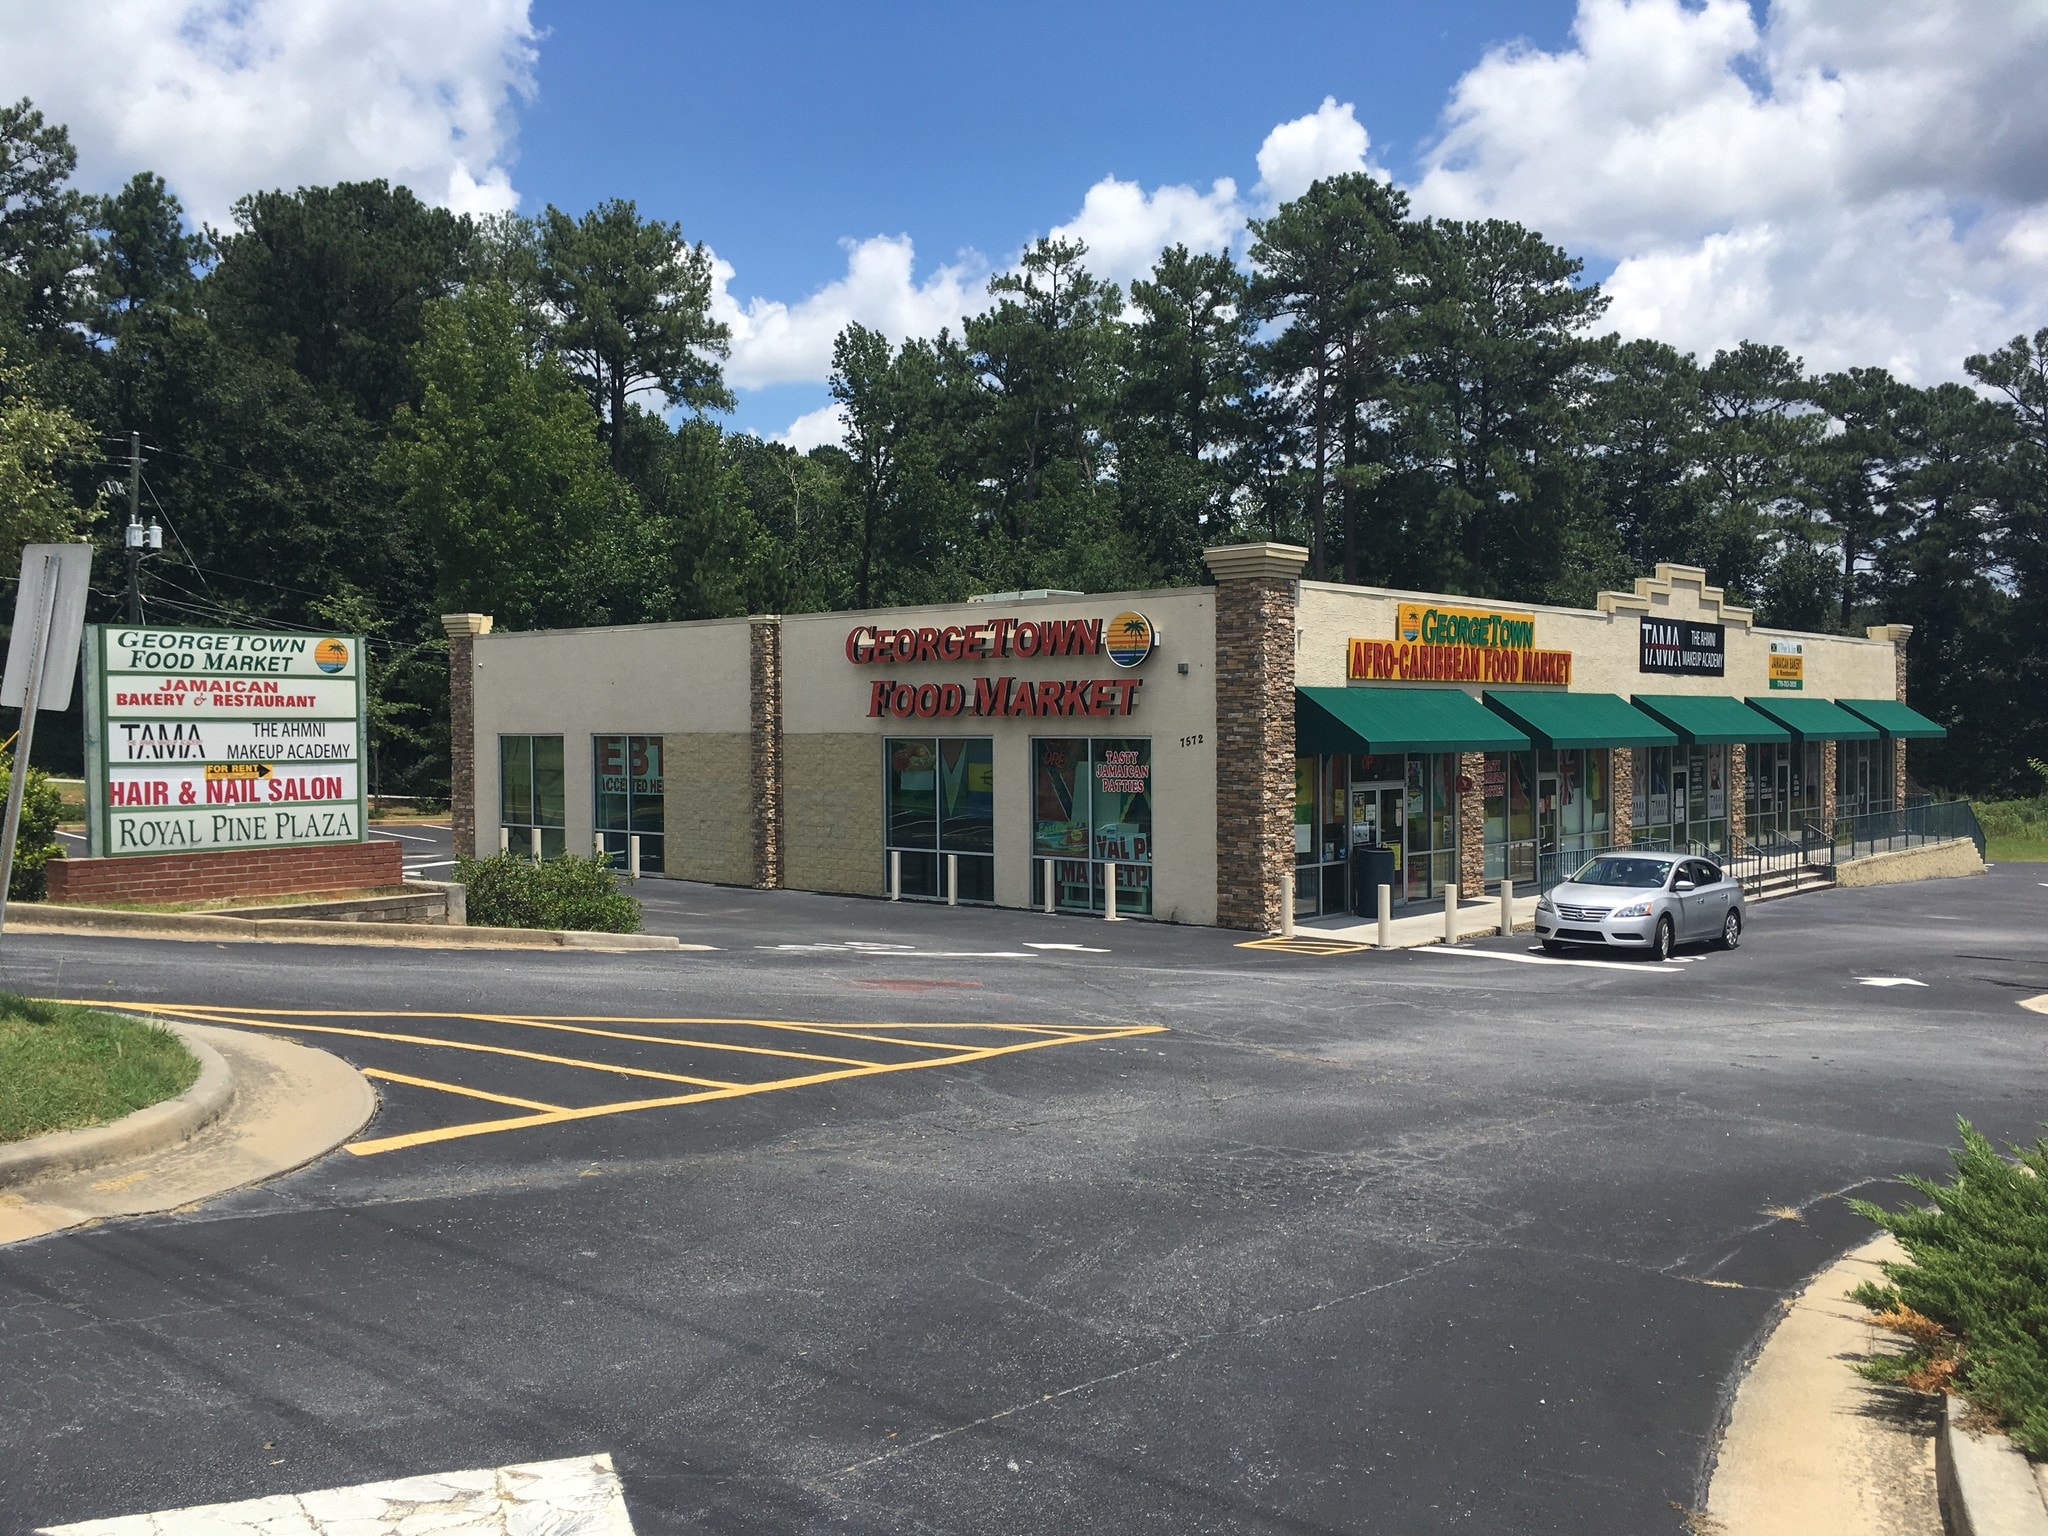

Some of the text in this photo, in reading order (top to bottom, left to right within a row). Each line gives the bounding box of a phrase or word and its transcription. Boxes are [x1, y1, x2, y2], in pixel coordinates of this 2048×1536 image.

[1422, 609, 1534, 648] GEORGETOWN
[118, 631, 306, 653] GEORGETOWN
[845, 618, 1103, 665] GEORGETOWN
[1691, 630, 1700, 646] THE
[129, 650, 293, 672] FOOD MARKET
[1352, 642, 1571, 684] AFRO-CARIBBEAN FOOD MARKET
[1682, 651, 1723, 668] MAKEUP ACADEMY
[159, 679, 278, 693] JAMAICAN
[116, 692, 316, 708] BAKERY & RESTAURANT
[866, 677, 1143, 718] FOOD MARKET
[253, 722, 326, 737] THE AHMNI
[1180, 734, 1204, 748] 7572
[227, 743, 350, 759] MAKEUP ACADEMY
[1105, 751, 1139, 764] TASTY
[207, 764, 258, 773] FOR RENT
[1096, 764, 1149, 778] JAMAICAN
[110, 777, 342, 806] HAIR & NAIL SALON
[602, 777, 647, 793] CCETED
[1102, 779, 1145, 793] PATTIES
[119, 812, 352, 847] ROYAL PINE PLAZA
